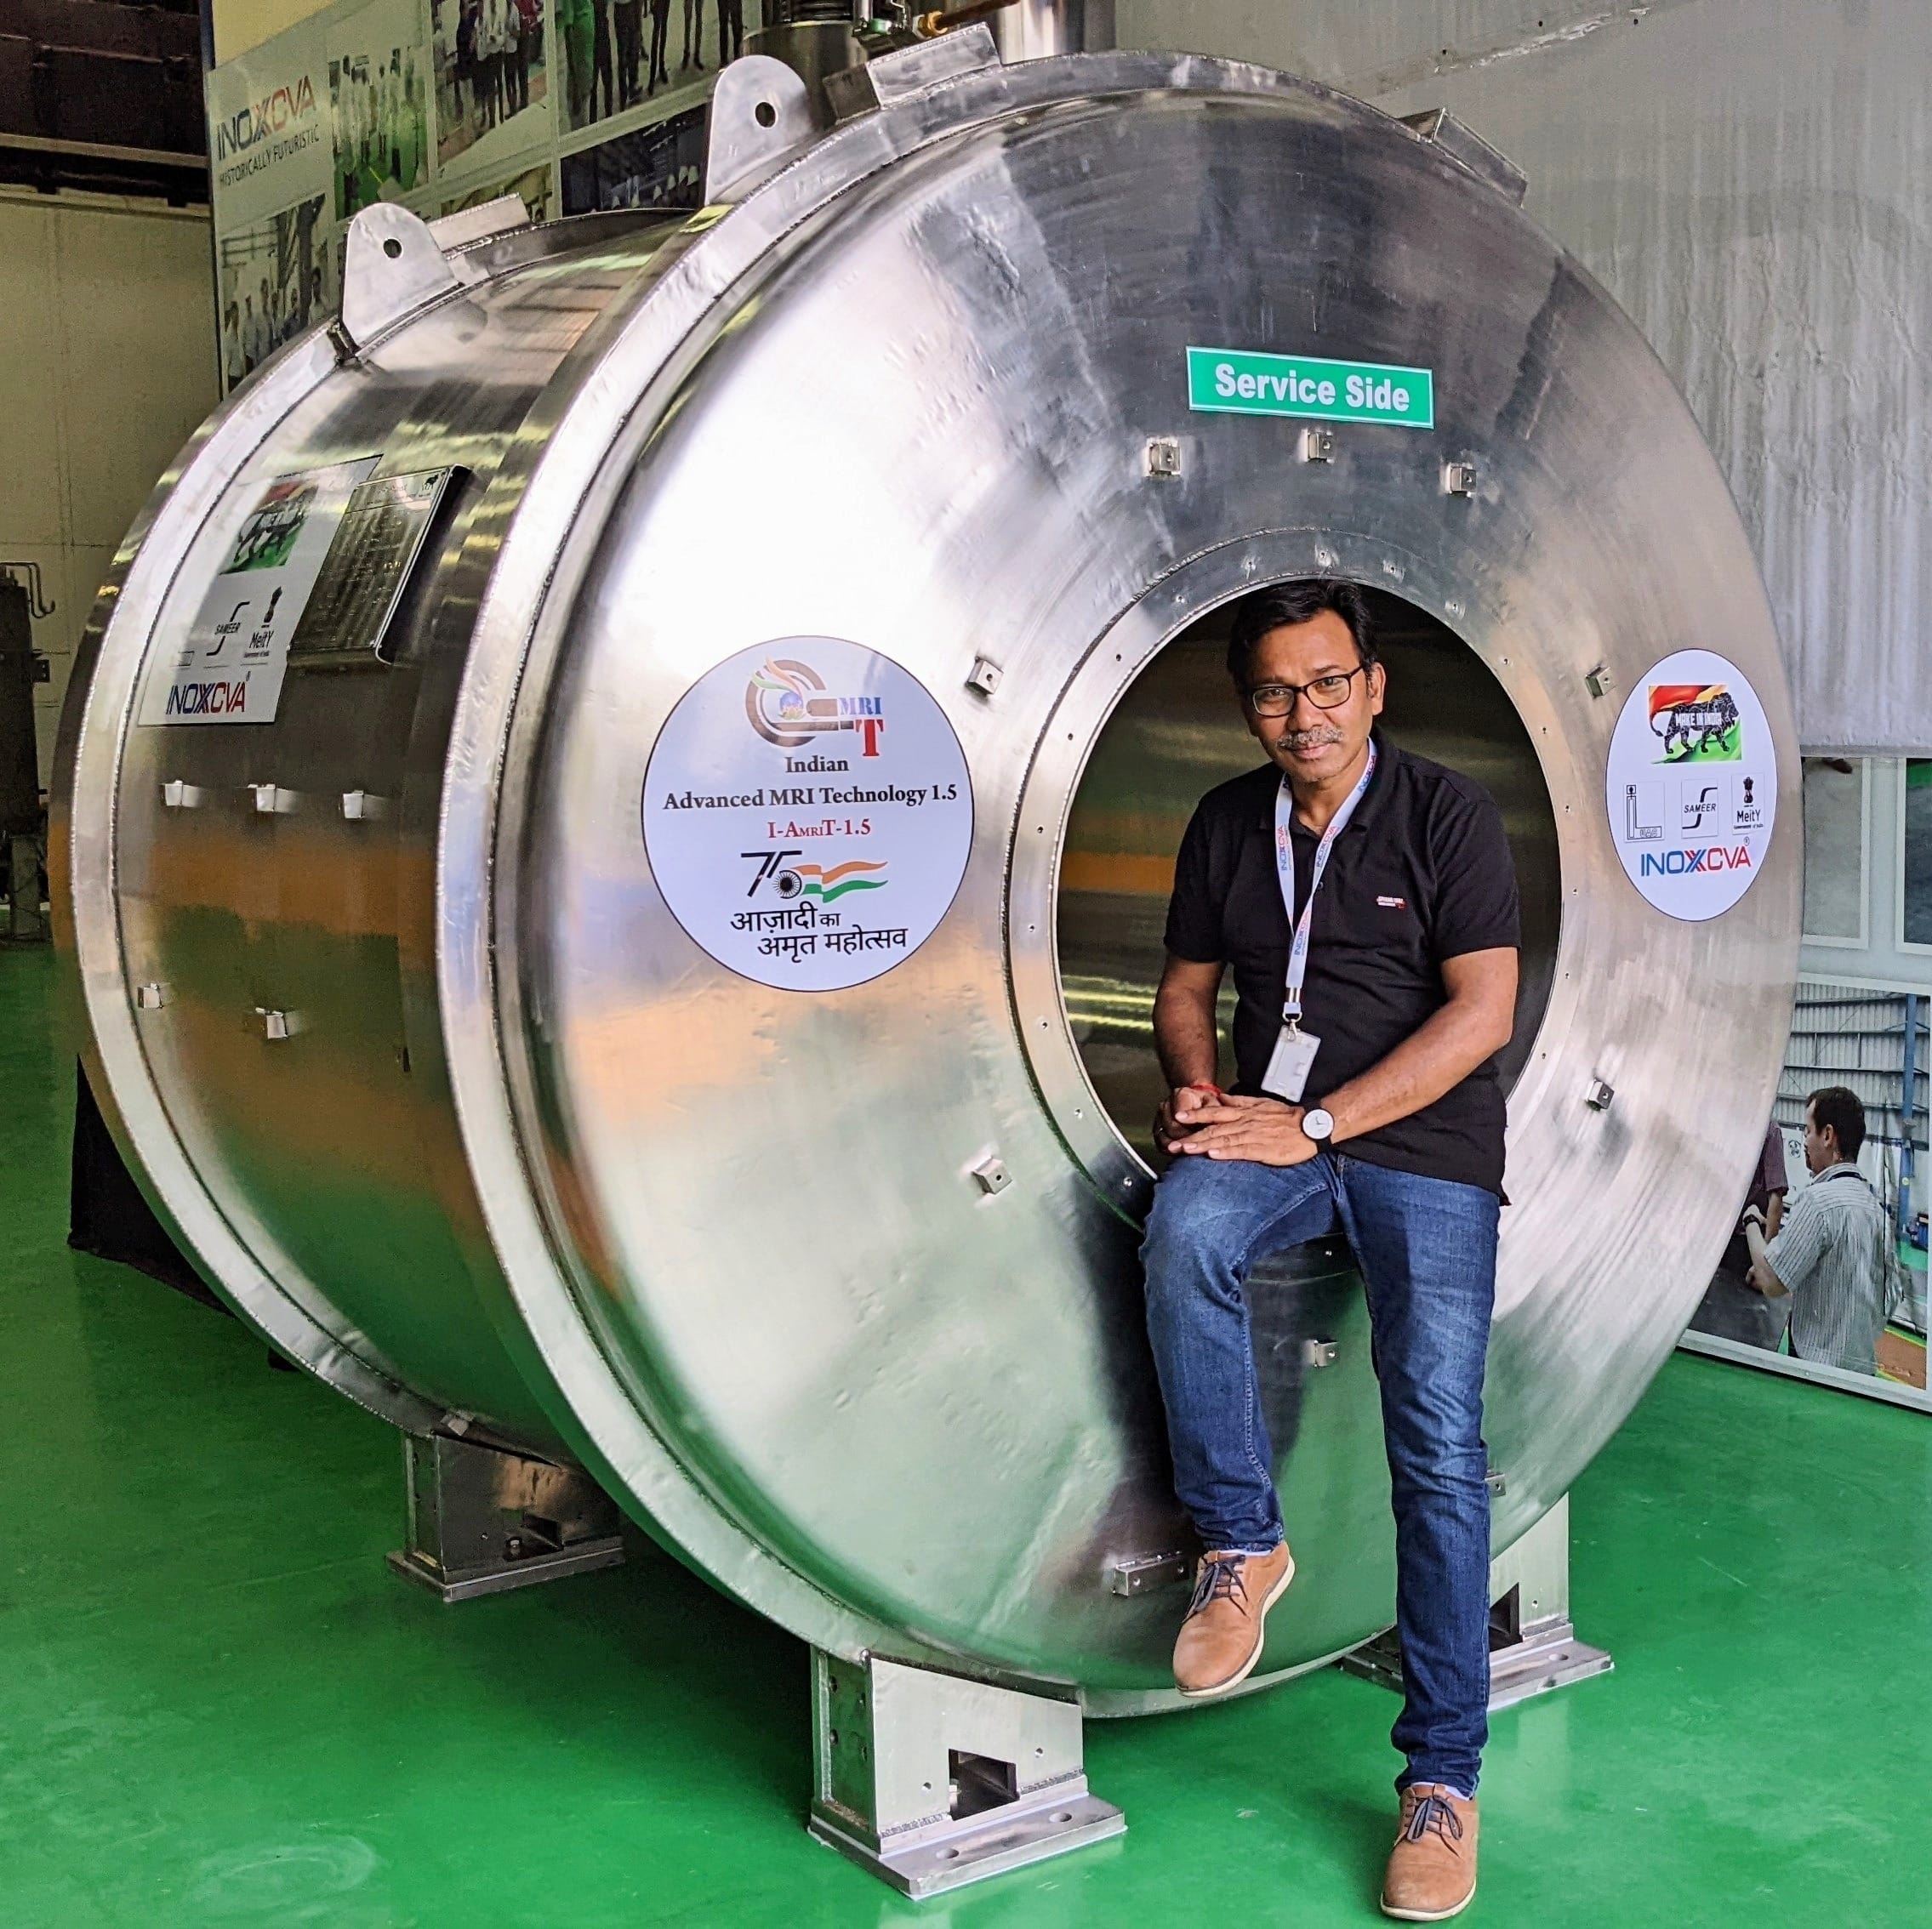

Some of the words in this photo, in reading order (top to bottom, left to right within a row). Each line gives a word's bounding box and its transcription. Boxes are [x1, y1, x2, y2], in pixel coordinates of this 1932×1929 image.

[219, 150, 272, 186] HISTORICALLY
[274, 123, 319, 162] FUTURISTIC
[1215, 362, 1336, 406] Service
[1345, 374, 1410, 412] Side
[839, 697, 882, 716] MRI
[855, 719, 884, 757] T
[784, 754, 849, 773] Indian
[663, 788, 765, 811] Advanced
[768, 788, 815, 806] MRI
[818, 784, 927, 806] Technology
[931, 783, 958, 801] 1.5
[1684, 803, 1717, 814] SAMEER
[1736, 809, 1761, 823] MeitY
[819, 912, 841, 927] का
[757, 933, 818, 964] अमृत
[824, 924, 909, 955] महोत्सव
